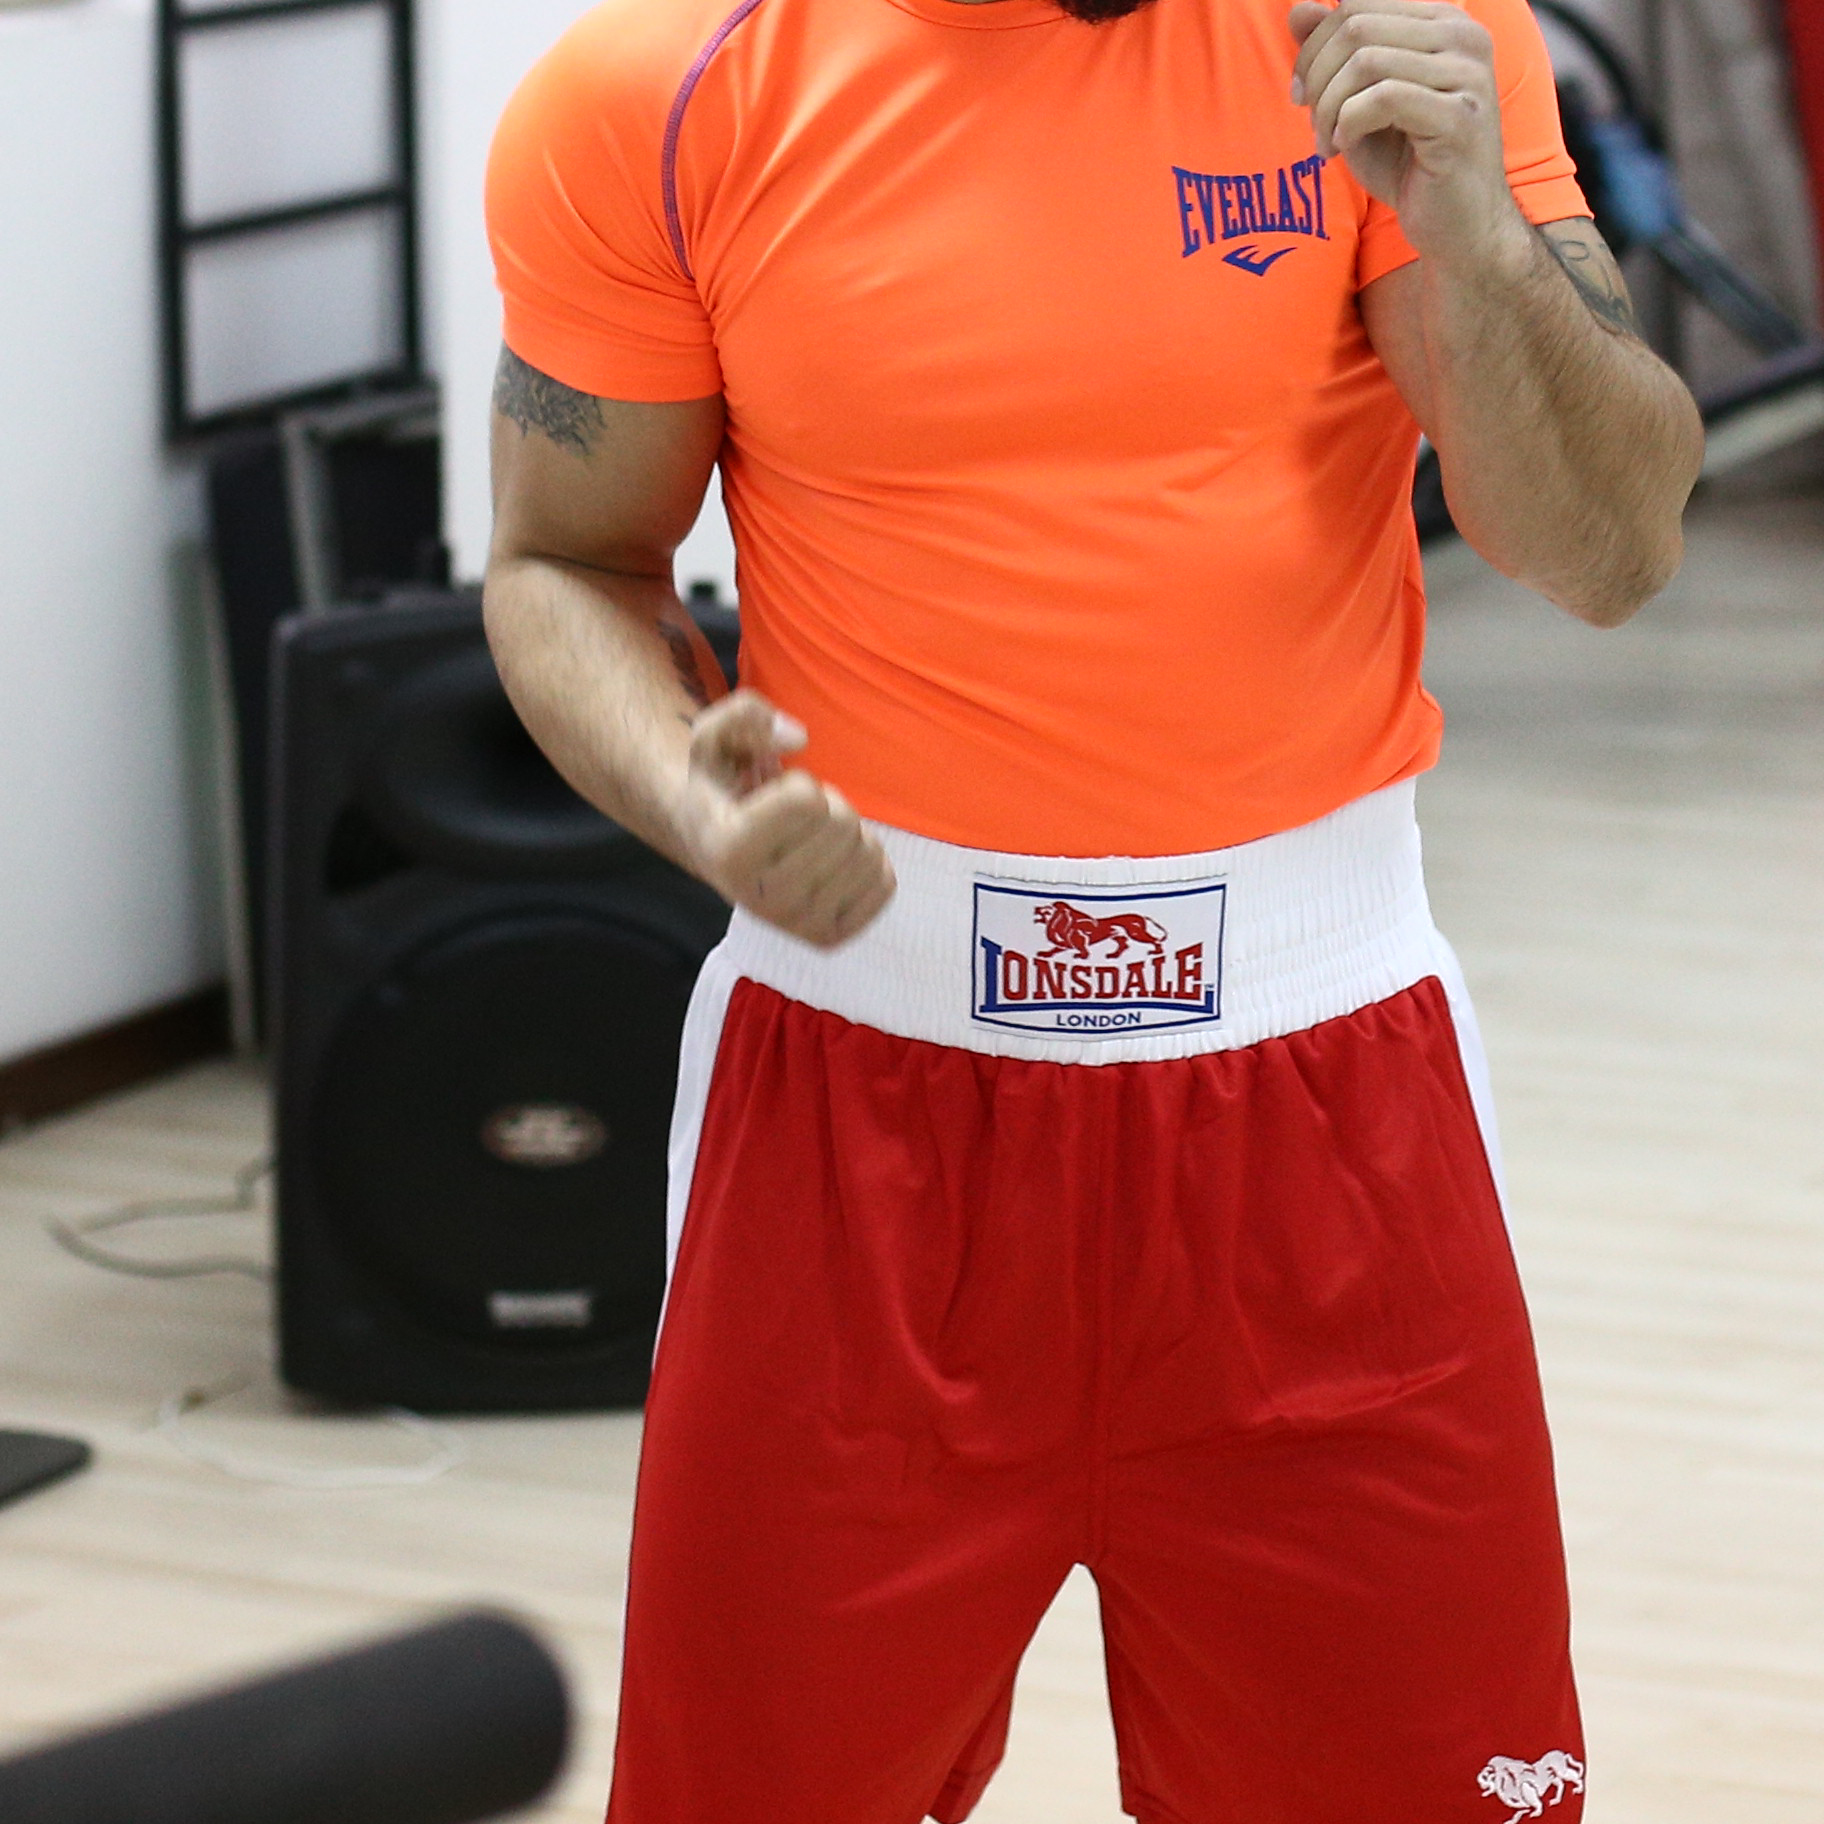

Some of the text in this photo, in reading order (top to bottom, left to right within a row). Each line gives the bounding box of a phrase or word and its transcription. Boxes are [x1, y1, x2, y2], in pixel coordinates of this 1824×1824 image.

[1171, 153, 1328, 258] EVERLAST
[979, 936, 1214, 1014] LONSDALE
[1056, 1012, 1142, 1027] LONDON
